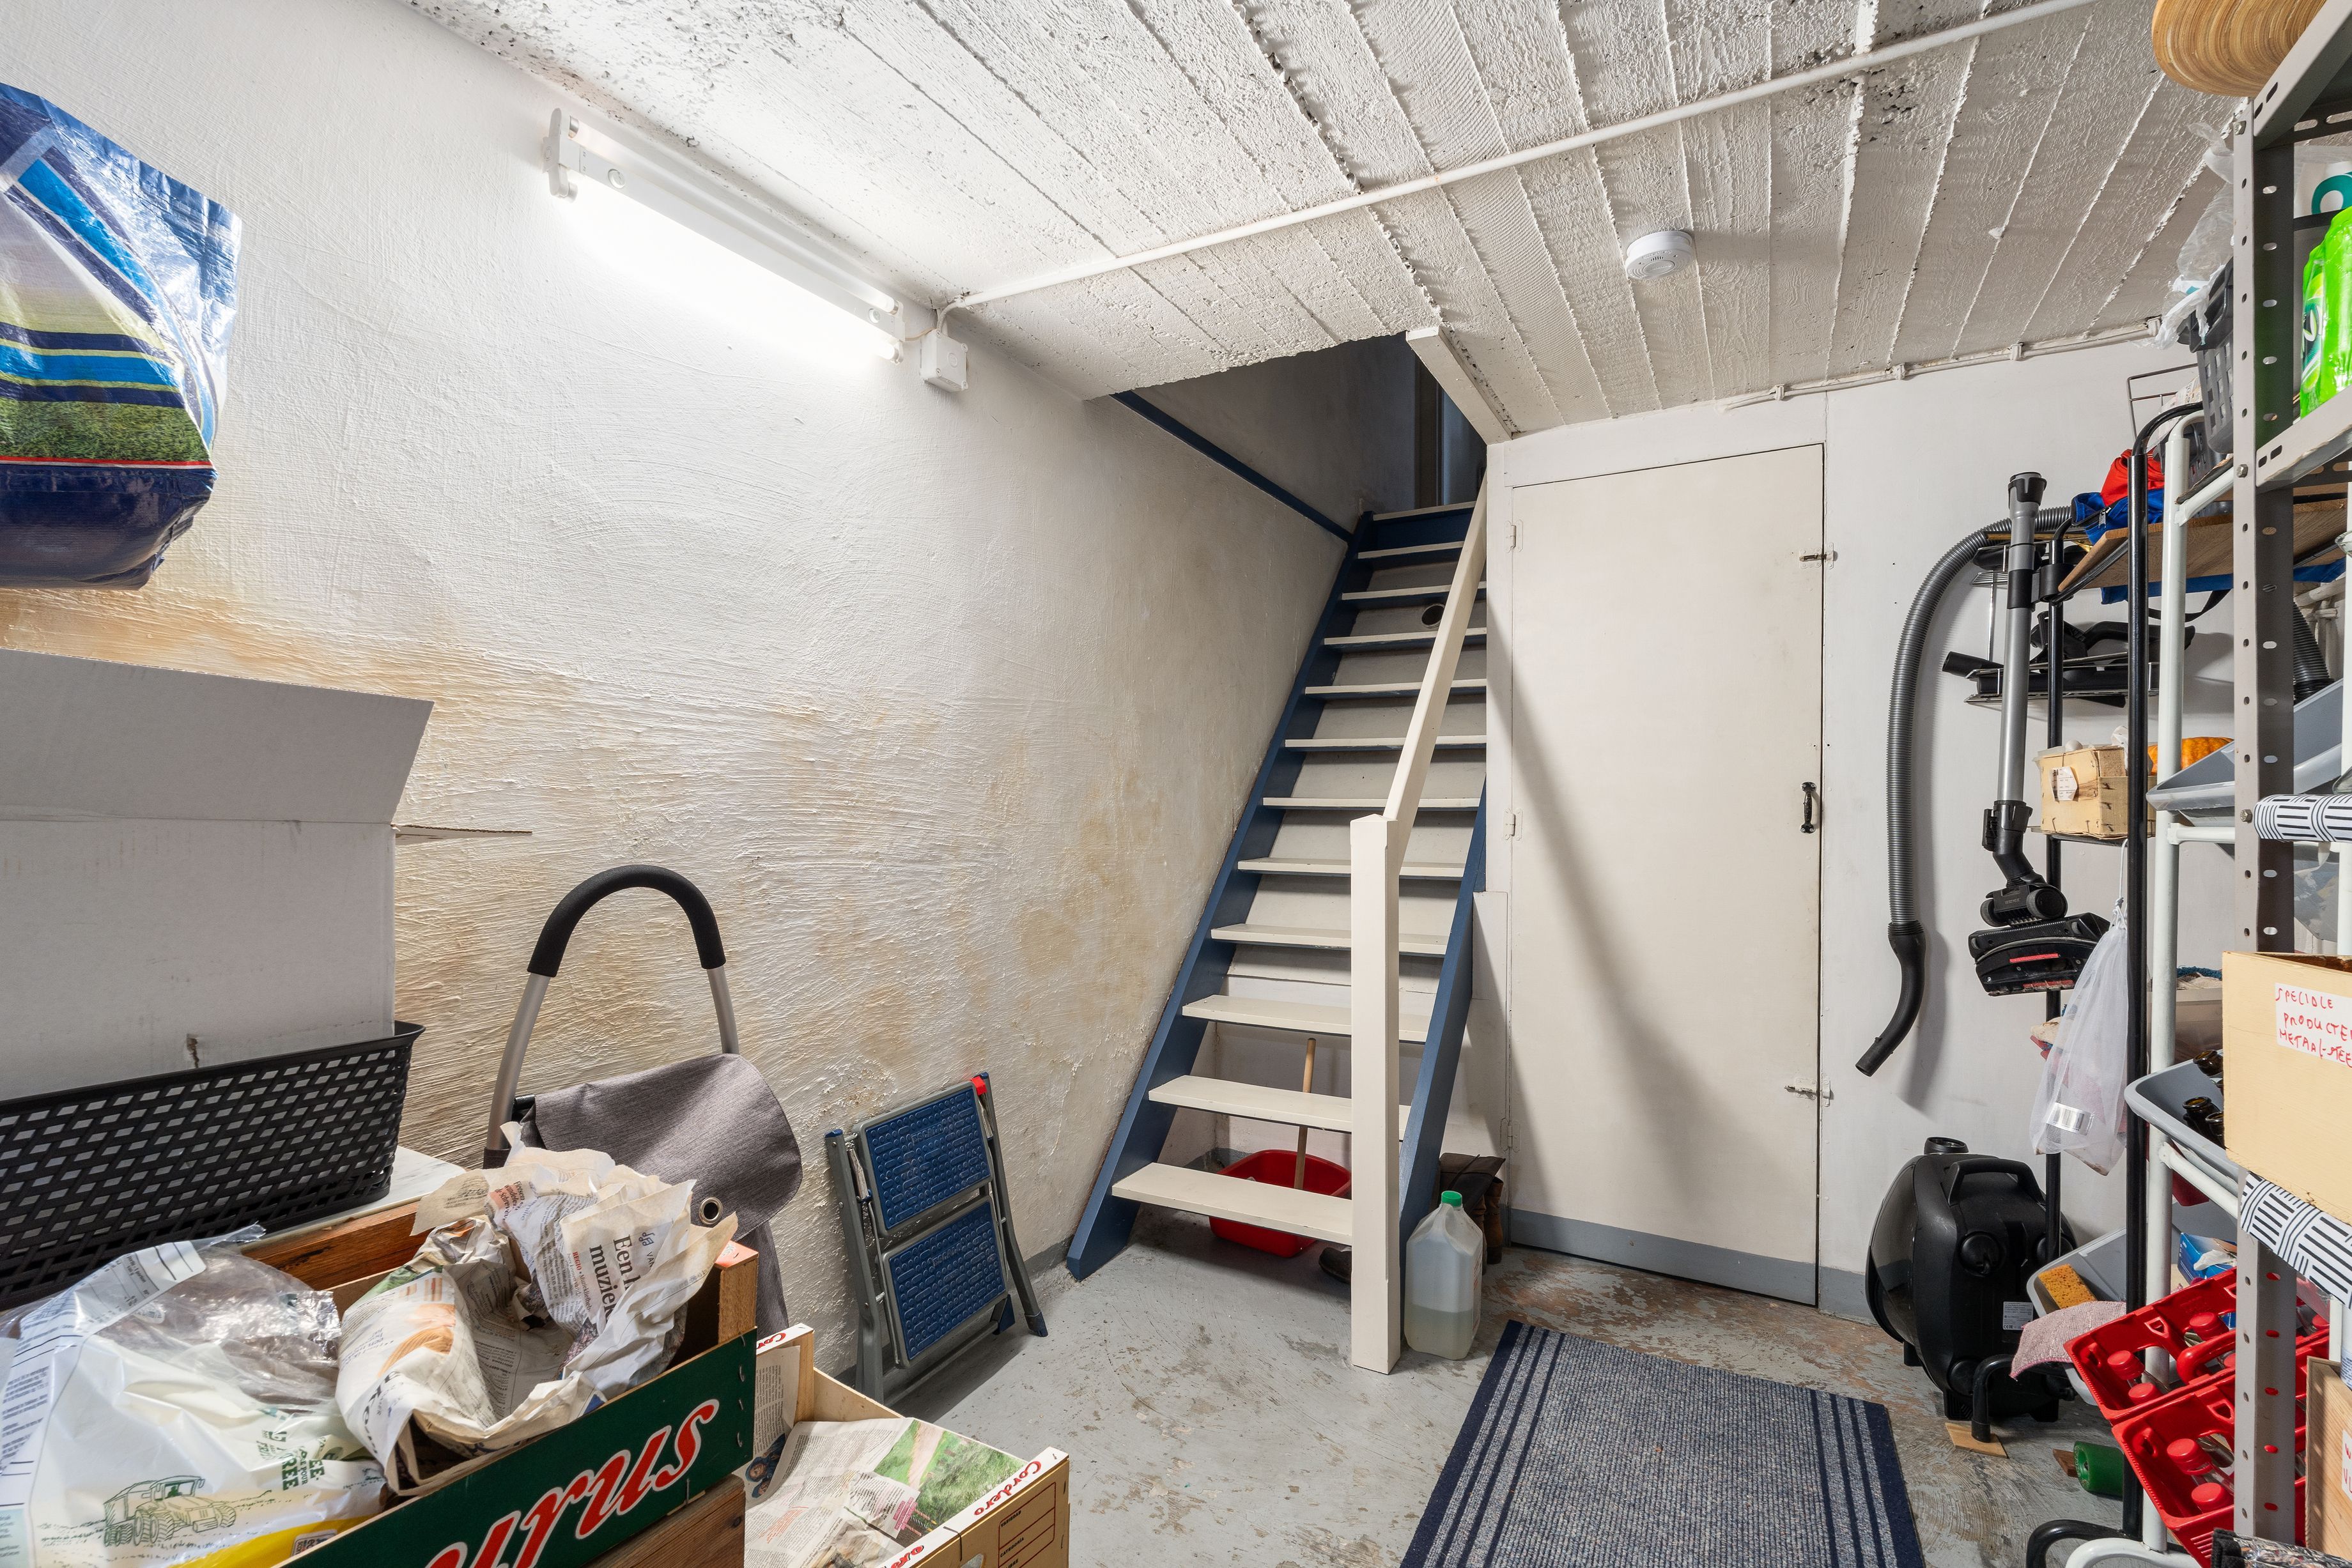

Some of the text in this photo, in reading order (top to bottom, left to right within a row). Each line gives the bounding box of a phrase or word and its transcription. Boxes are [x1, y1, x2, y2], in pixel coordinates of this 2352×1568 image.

[573, 1251, 582, 1270] REGIO
[614, 1234, 633, 1275] Een
[973, 1461, 1042, 1516] Cordero
